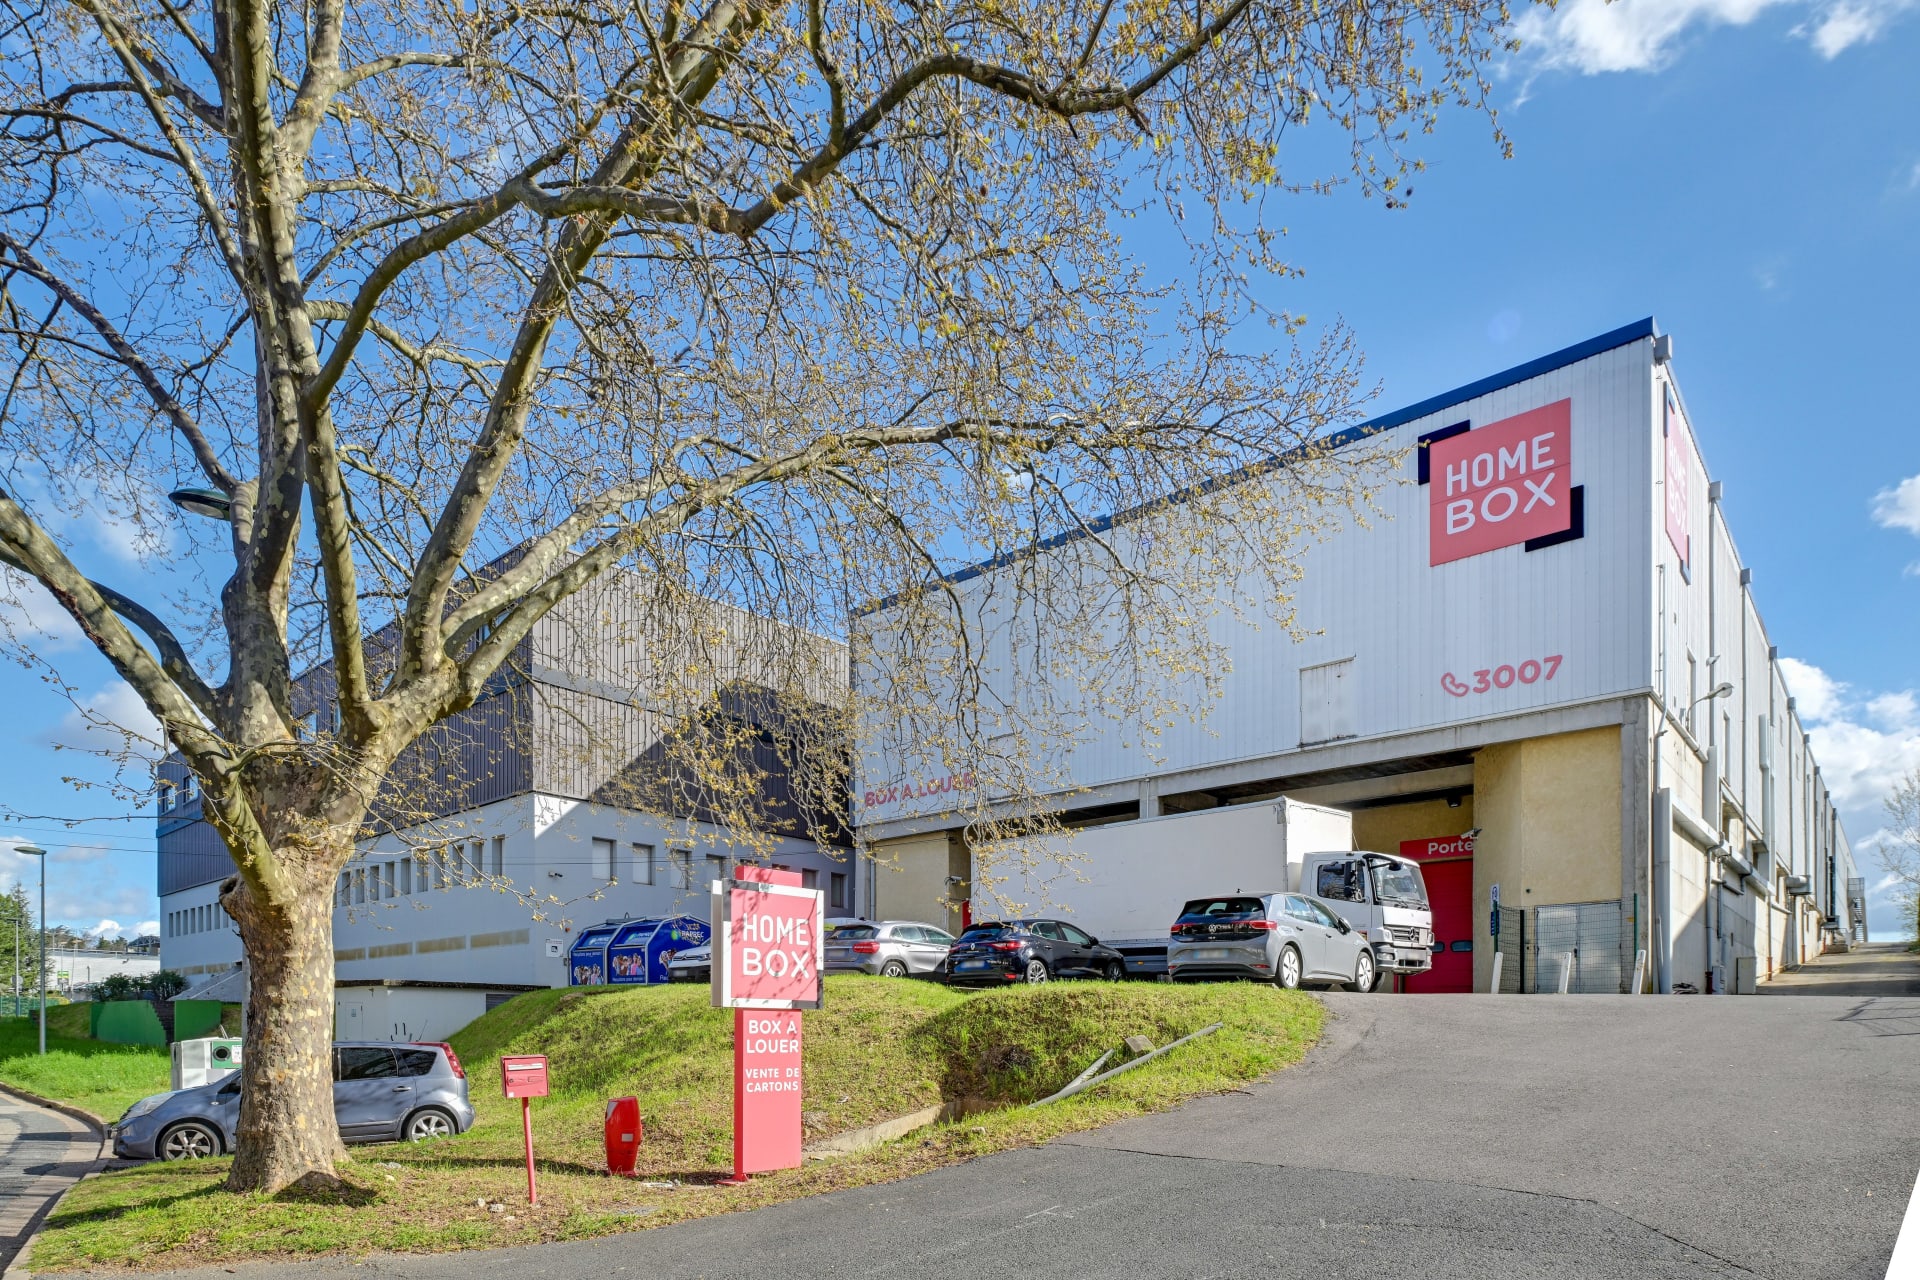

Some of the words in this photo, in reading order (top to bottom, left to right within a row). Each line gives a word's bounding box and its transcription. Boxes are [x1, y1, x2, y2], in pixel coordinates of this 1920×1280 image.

[1446, 431, 1555, 496] HOME
[1446, 472, 1556, 535] BOX
[1473, 654, 1563, 694] 3007
[865, 787, 898, 807] BOX
[902, 784, 913, 801] A
[1428, 839, 1473, 855] Porte
[743, 912, 810, 946] HOME
[743, 948, 810, 979] BOX
[748, 1019, 782, 1035] BOX
[786, 1020, 798, 1034] A
[746, 1039, 799, 1054] LOUER
[746, 1067, 779, 1079] VENTE
[786, 1067, 800, 1078] DE
[746, 1082, 799, 1093] CARTONS
